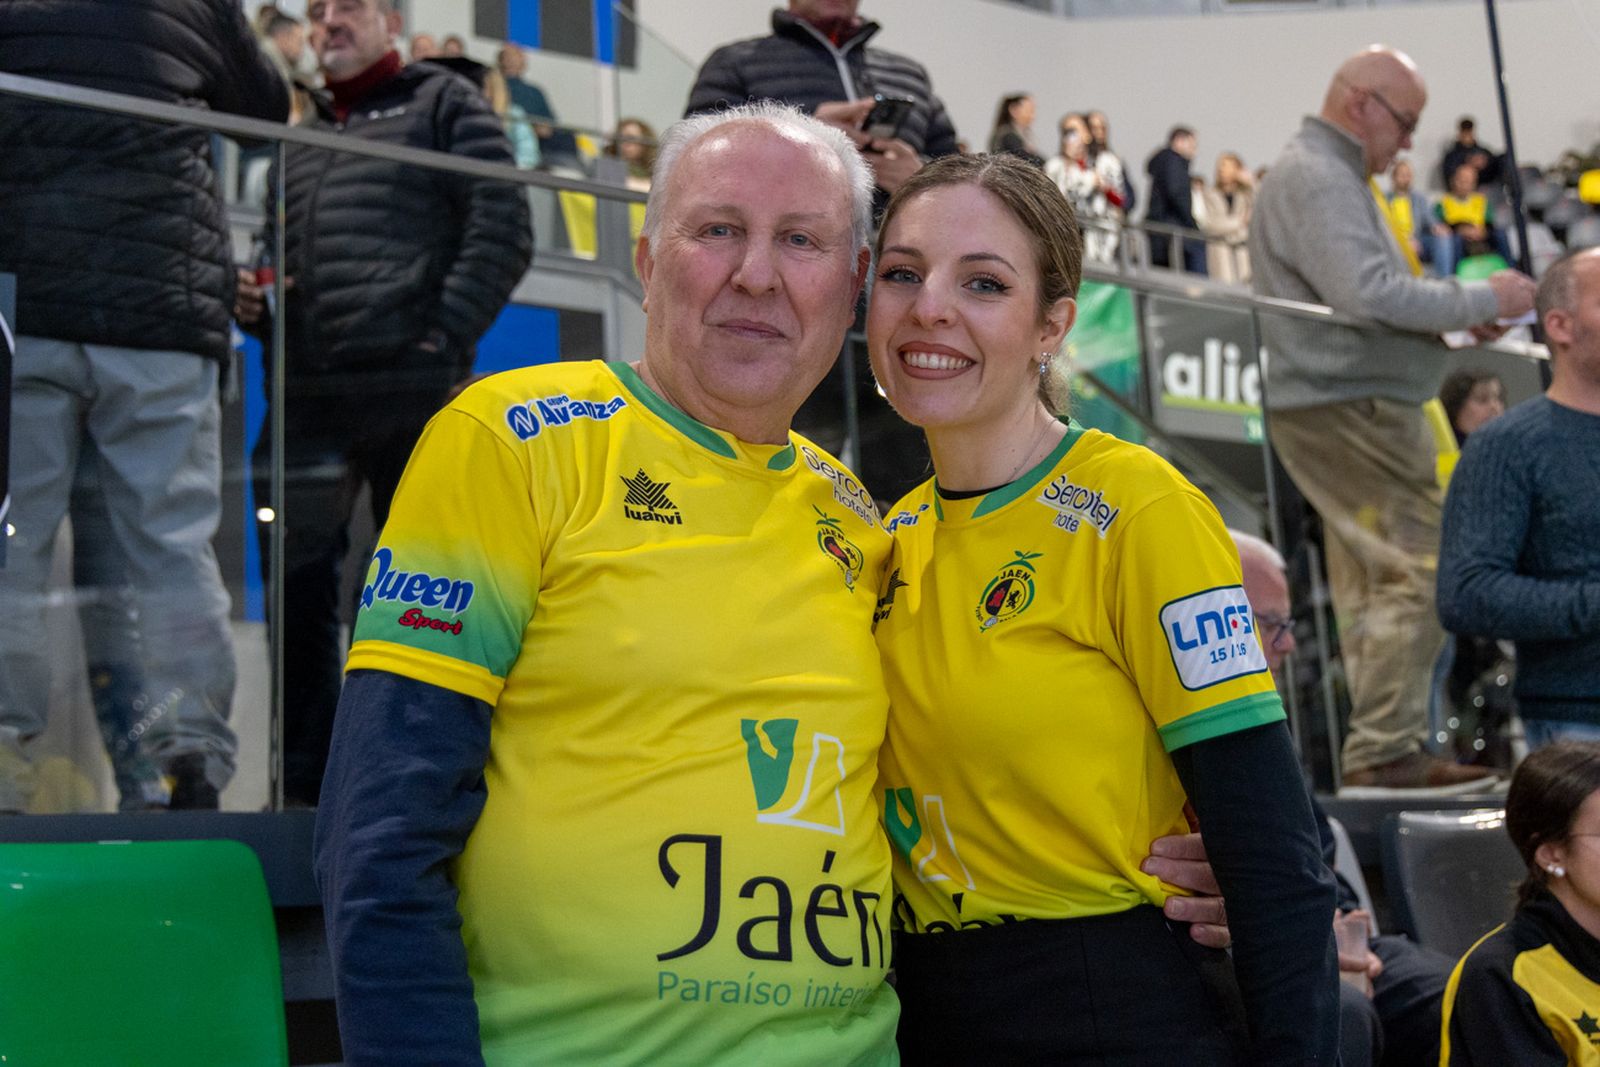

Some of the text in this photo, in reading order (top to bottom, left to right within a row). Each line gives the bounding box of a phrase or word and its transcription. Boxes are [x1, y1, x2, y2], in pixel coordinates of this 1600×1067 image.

[535, 396, 626, 426] Avanza
[624, 504, 683, 525] luanvi
[360, 547, 474, 614] Queen
[1000, 569, 1031, 581] JAEN
[398, 608, 463, 635] Sport
[656, 833, 884, 969] Jaén
[658, 971, 792, 1006] Paraíso
